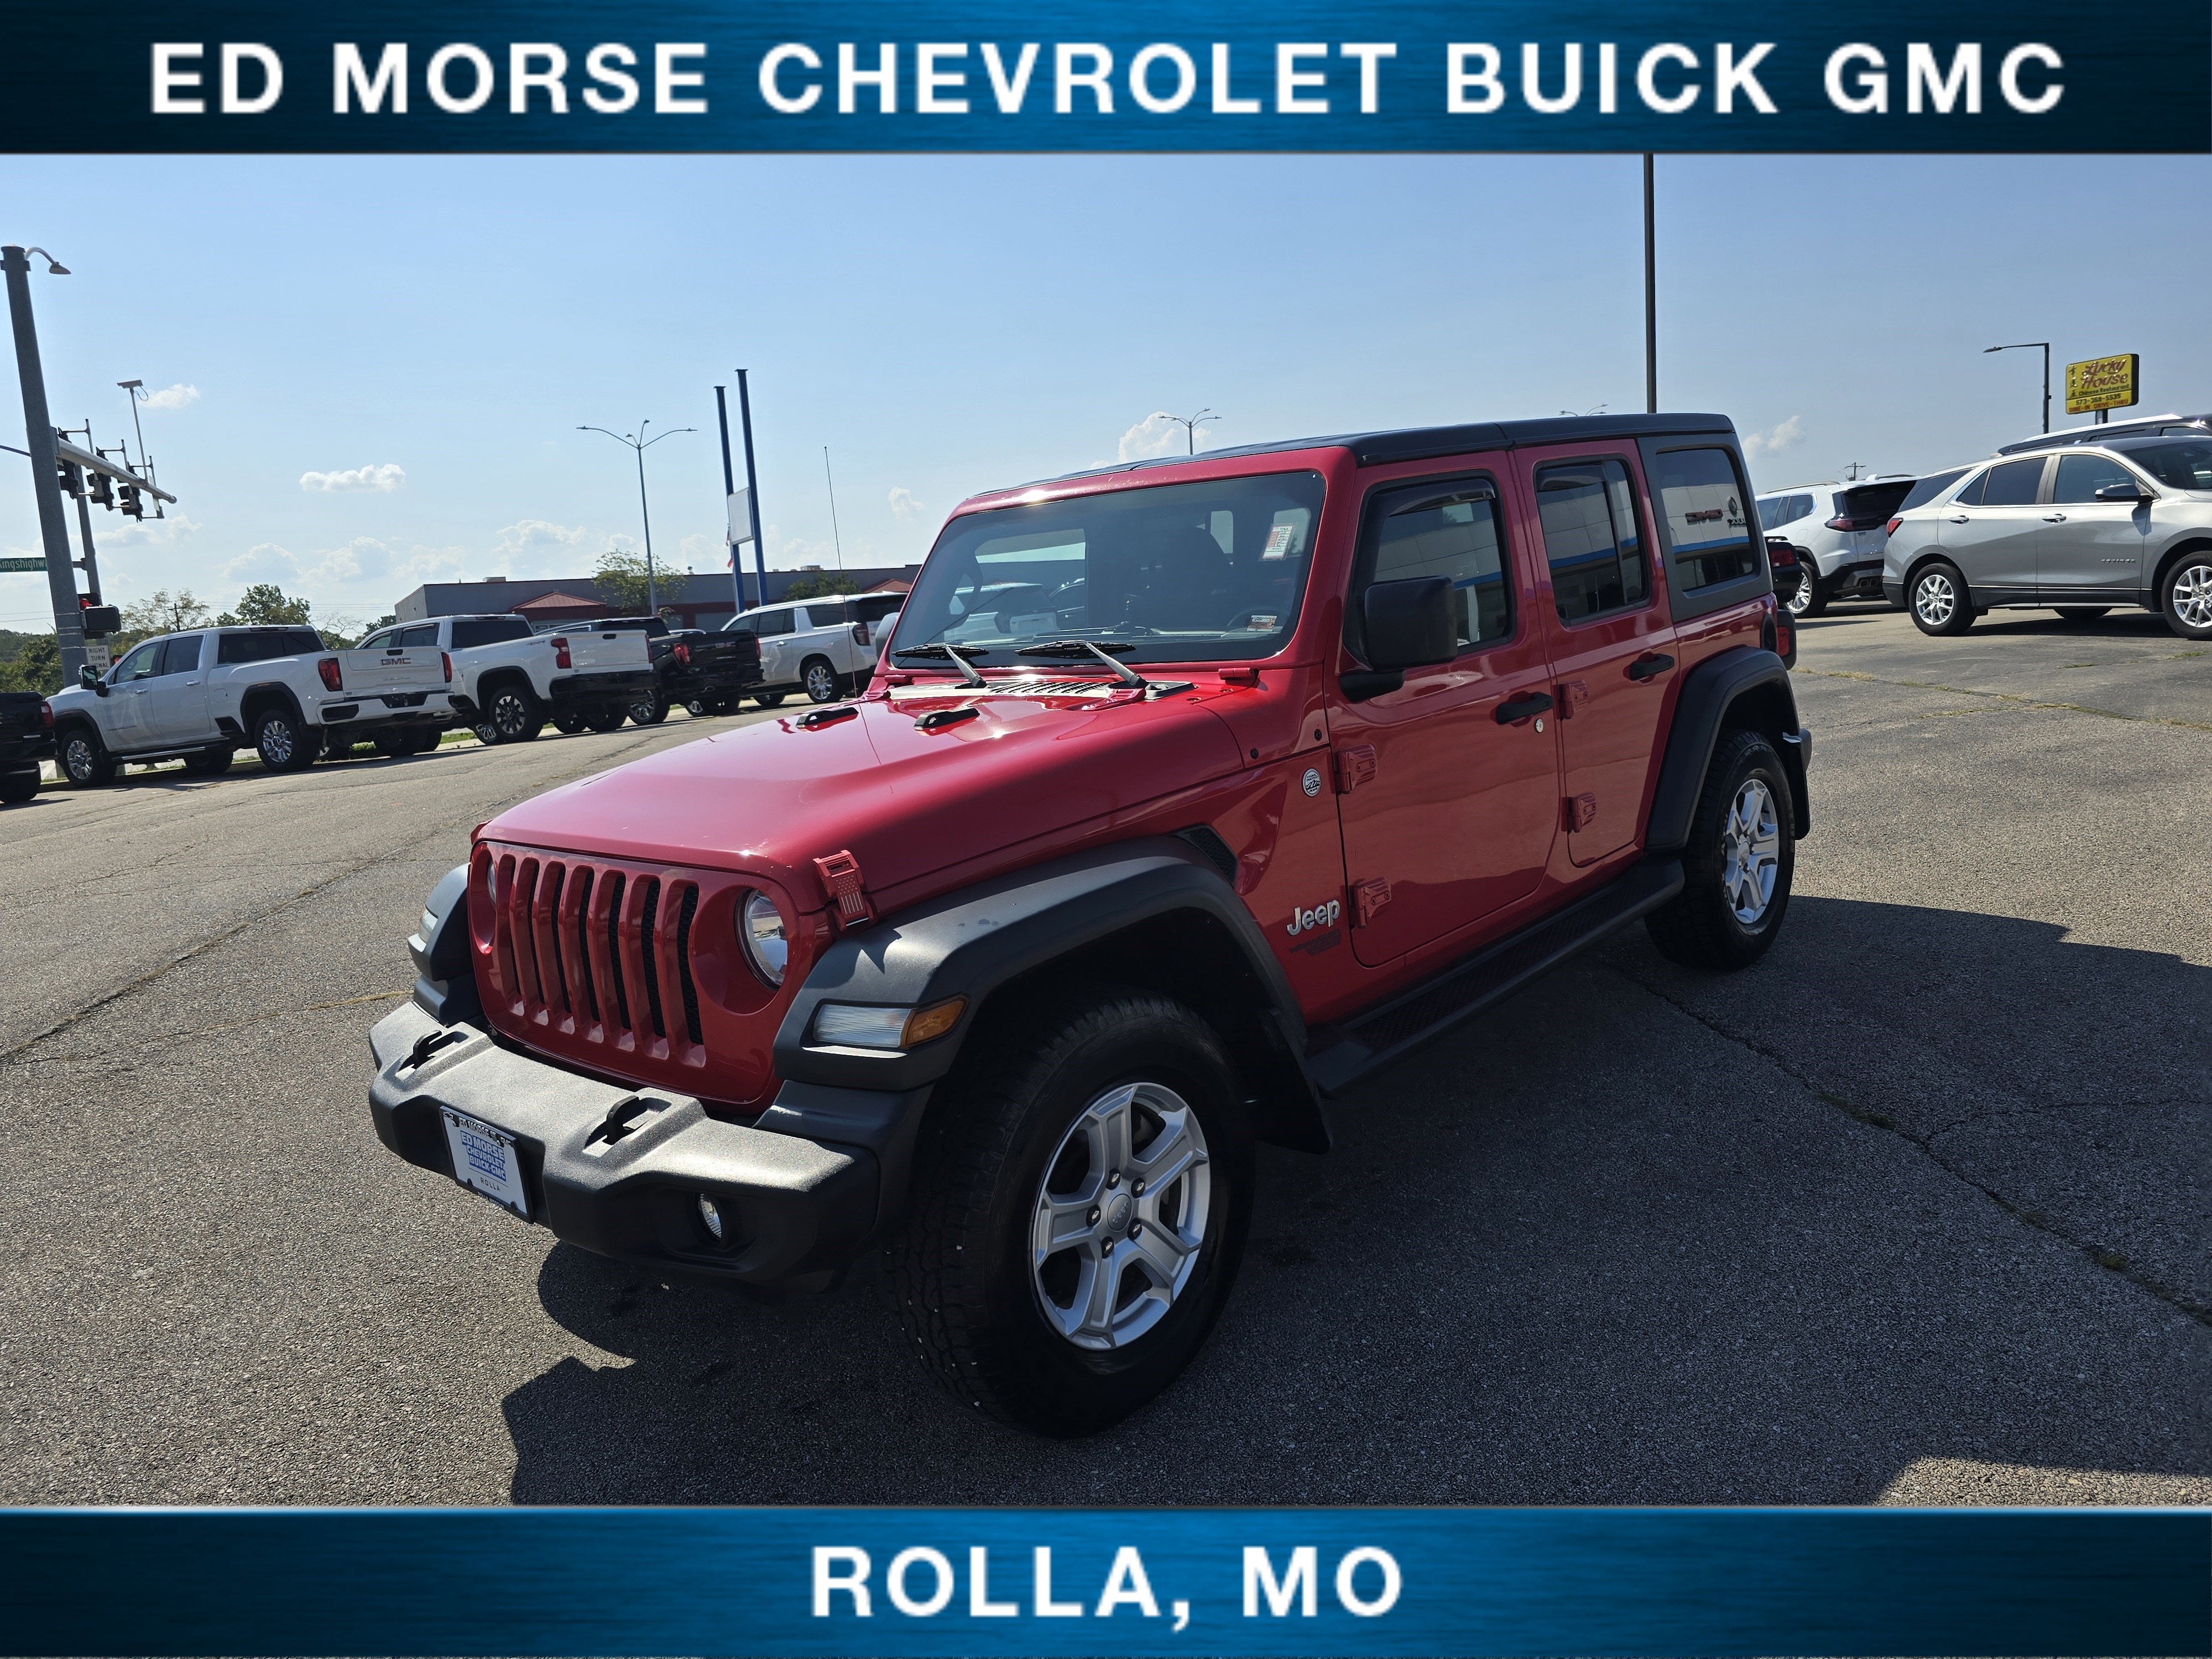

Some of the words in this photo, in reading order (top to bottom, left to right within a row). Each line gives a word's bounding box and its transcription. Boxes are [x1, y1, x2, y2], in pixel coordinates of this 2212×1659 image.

[2082, 359, 2127, 376] Lucky
[2080, 373, 2128, 389] House
[2100, 384, 2129, 393] Restaurant
[2094, 399, 2128, 409] DRIVE-THRU
[0, 559, 48, 571] ingshighw
[380, 658, 411, 666] GMC
[1287, 900, 1340, 936] Jeep
[461, 1131, 473, 1145] ED
[473, 1136, 505, 1161] MORSE
[466, 1145, 504, 1168] CHEVROLET
[480, 1177, 501, 1192] ROLLA
